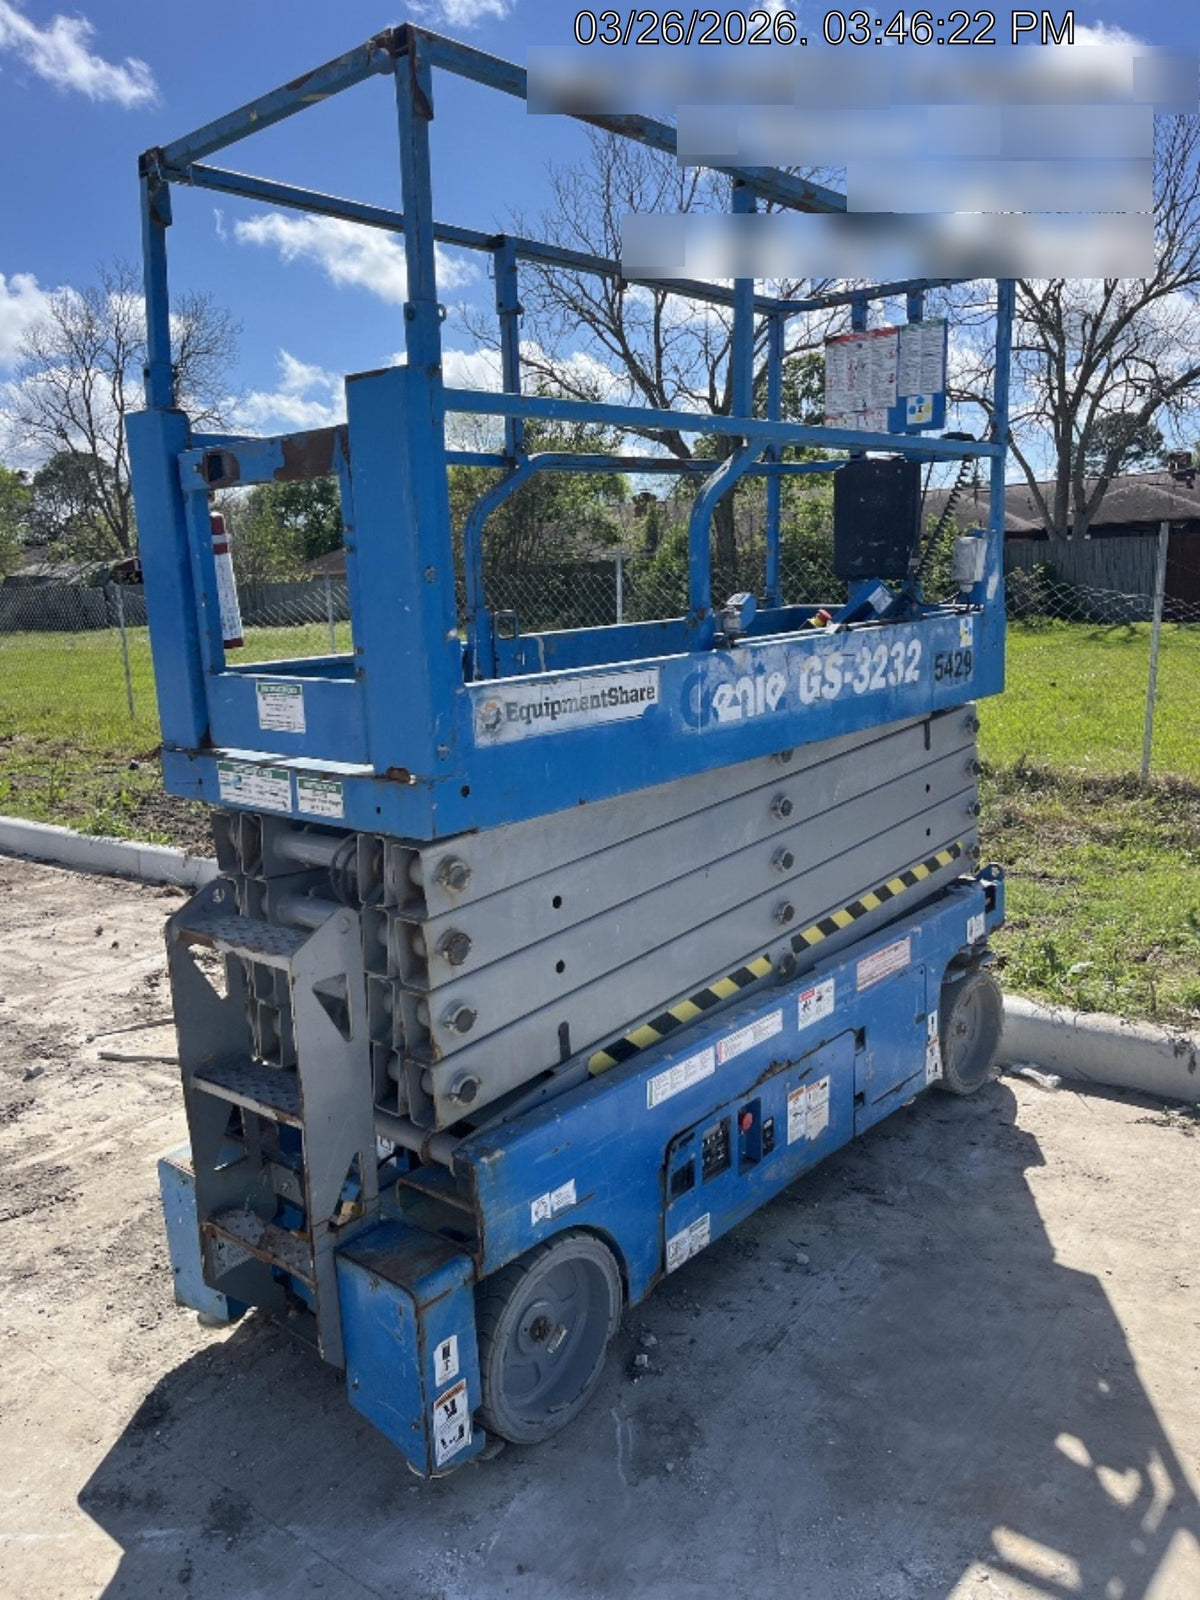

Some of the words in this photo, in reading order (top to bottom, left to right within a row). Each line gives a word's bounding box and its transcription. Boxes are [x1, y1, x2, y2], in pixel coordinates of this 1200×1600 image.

[799, 638, 922, 705] GS-3232
[934, 650, 972, 682] 5429
[504, 685, 656, 725] EquipmentShare
